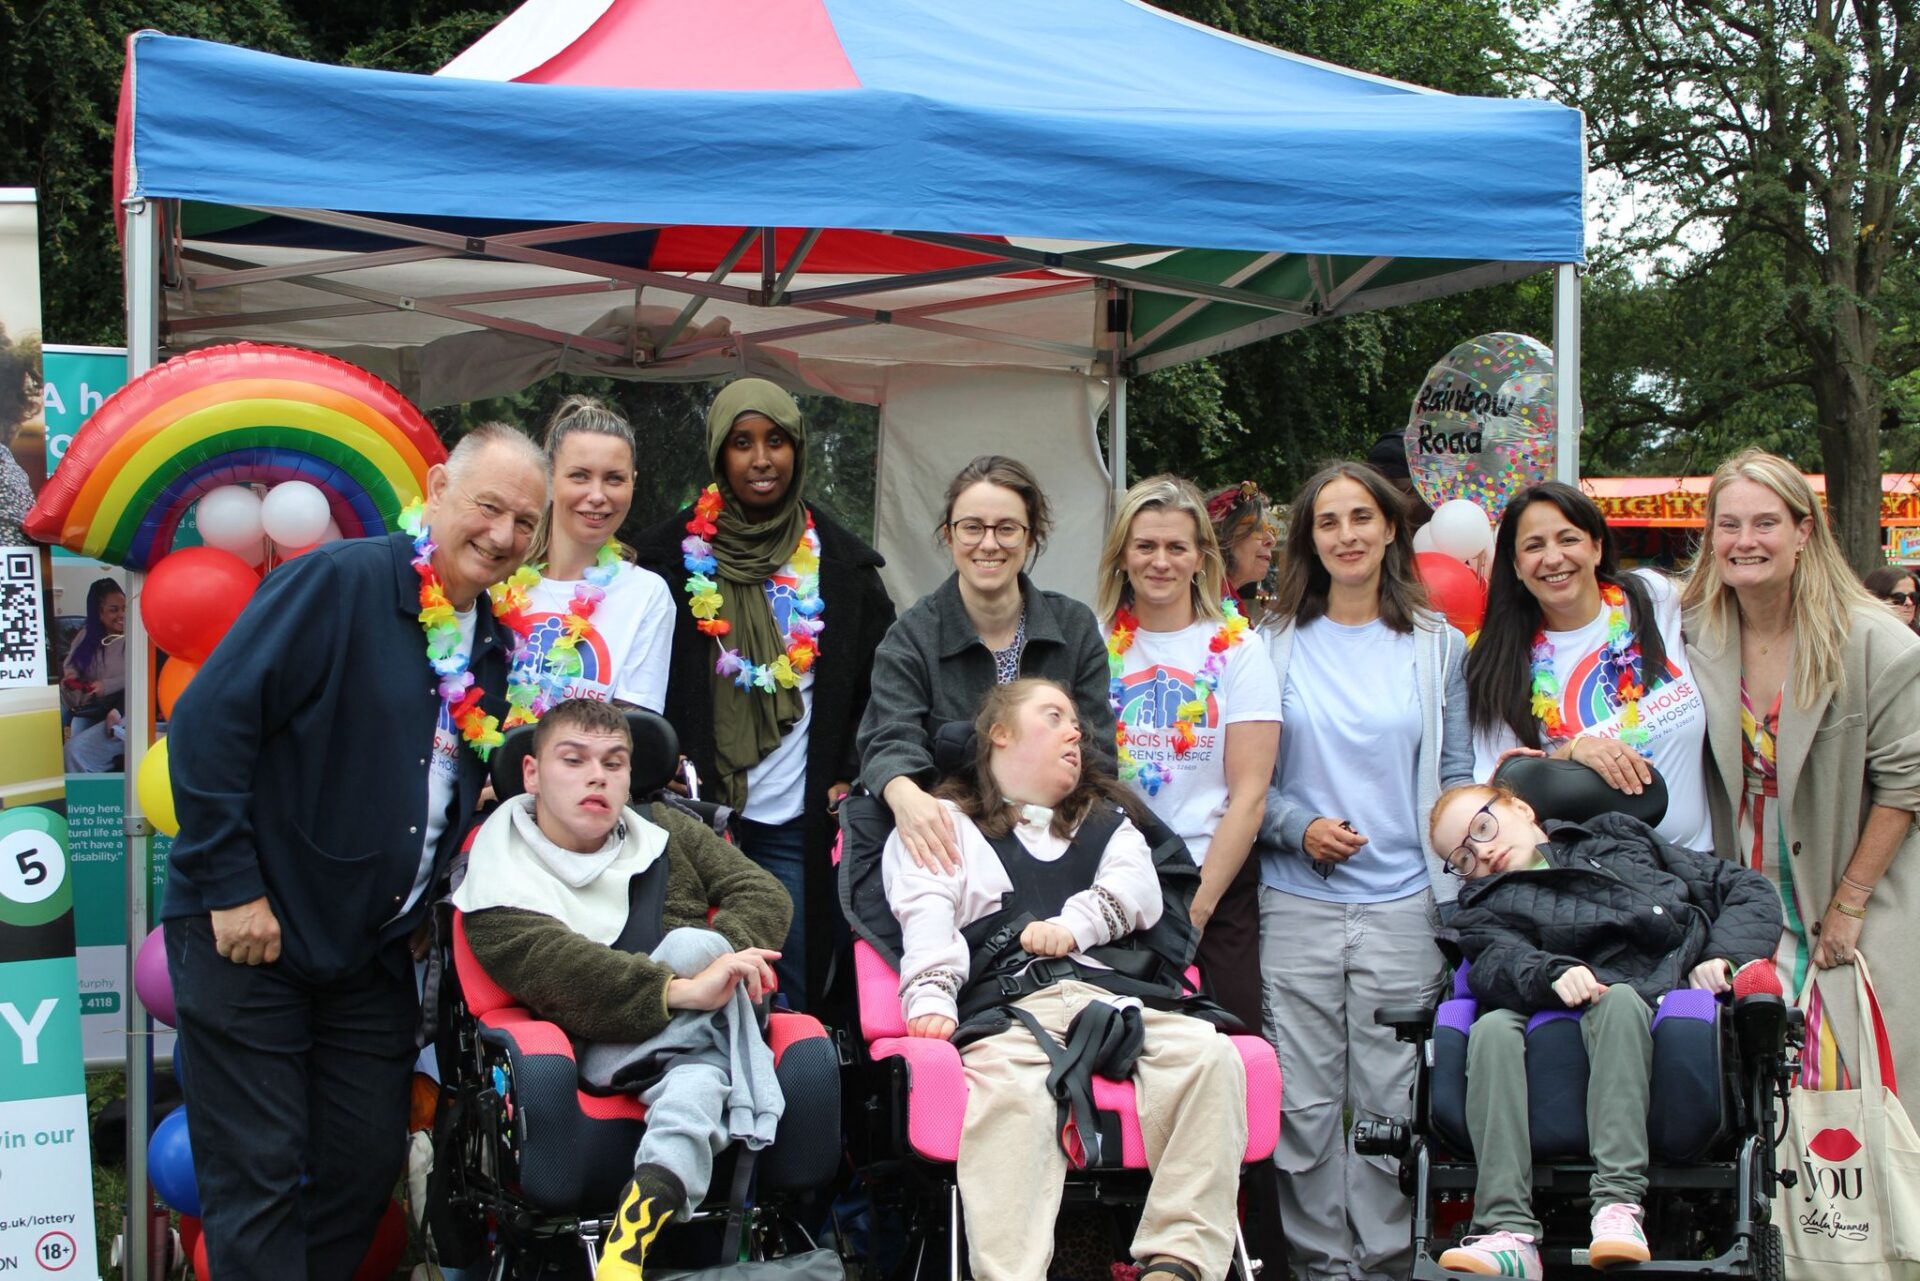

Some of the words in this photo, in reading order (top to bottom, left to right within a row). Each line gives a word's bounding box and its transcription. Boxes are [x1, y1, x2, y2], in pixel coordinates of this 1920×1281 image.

[43, 382, 66, 414] A
[1417, 382, 1517, 418] Rainbow
[1418, 422, 1485, 454] Road
[0, 669, 34, 679] PLAY
[562, 685, 606, 702] OUSE
[1647, 682, 1694, 715] HOUSE
[1657, 696, 1700, 726] HOSPICE
[1124, 733, 1160, 748] NCIS
[1165, 735, 1215, 748] HUSE
[1167, 750, 1212, 761] HOSPICE
[67, 804, 96, 815] living
[97, 804, 123, 814] here.
[69, 818, 81, 826] us
[96, 817, 115, 825] live
[68, 829, 91, 838] tural
[94, 828, 109, 837] life
[111, 829, 123, 837] as
[90, 840, 114, 849] have
[116, 841, 123, 849] a
[16, 848, 47, 886] 5
[87, 997, 112, 1007] 4118
[0, 998, 59, 1065] Y
[34, 1128, 75, 1146] our
[0, 1213, 75, 1231] g.uk/lottery
[42, 1243, 70, 1260] 18+
